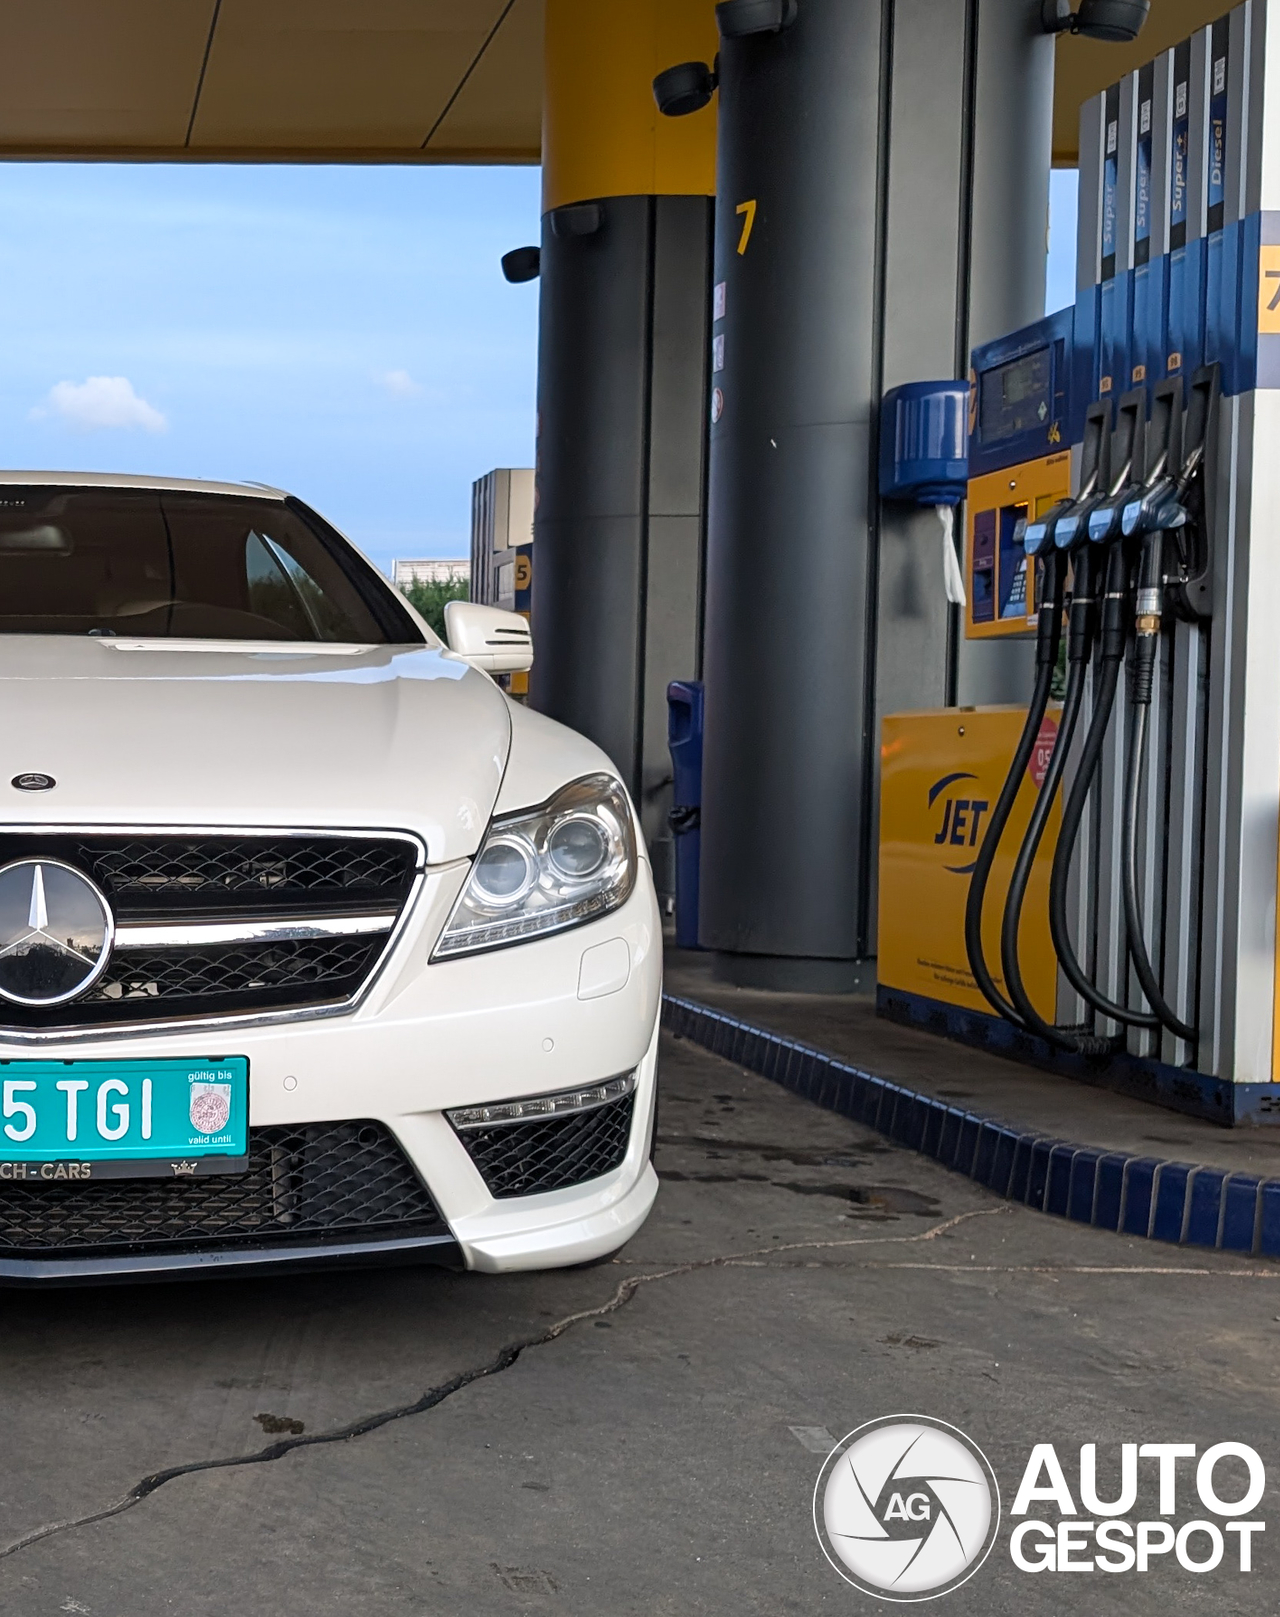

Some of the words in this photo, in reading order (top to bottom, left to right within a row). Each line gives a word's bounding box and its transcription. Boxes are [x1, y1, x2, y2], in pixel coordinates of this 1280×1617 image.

[1211, 119, 1223, 186] Diesel
[1136, 168, 1149, 228] Super
[1173, 152, 1186, 212] Super
[735, 199, 757, 256] 7
[1103, 182, 1115, 244] Super
[1264, 270, 1280, 311] 7
[517, 564, 528, 581] 5
[934, 798, 989, 847] JET
[187, 1071, 216, 1083] gültig
[217, 1070, 233, 1080] bis
[3, 1080, 37, 1142] 5
[56, 1078, 152, 1141] TGI
[188, 1135, 210, 1145] valid
[211, 1134, 232, 1144] until
[40, 1163, 91, 1179] CARS
